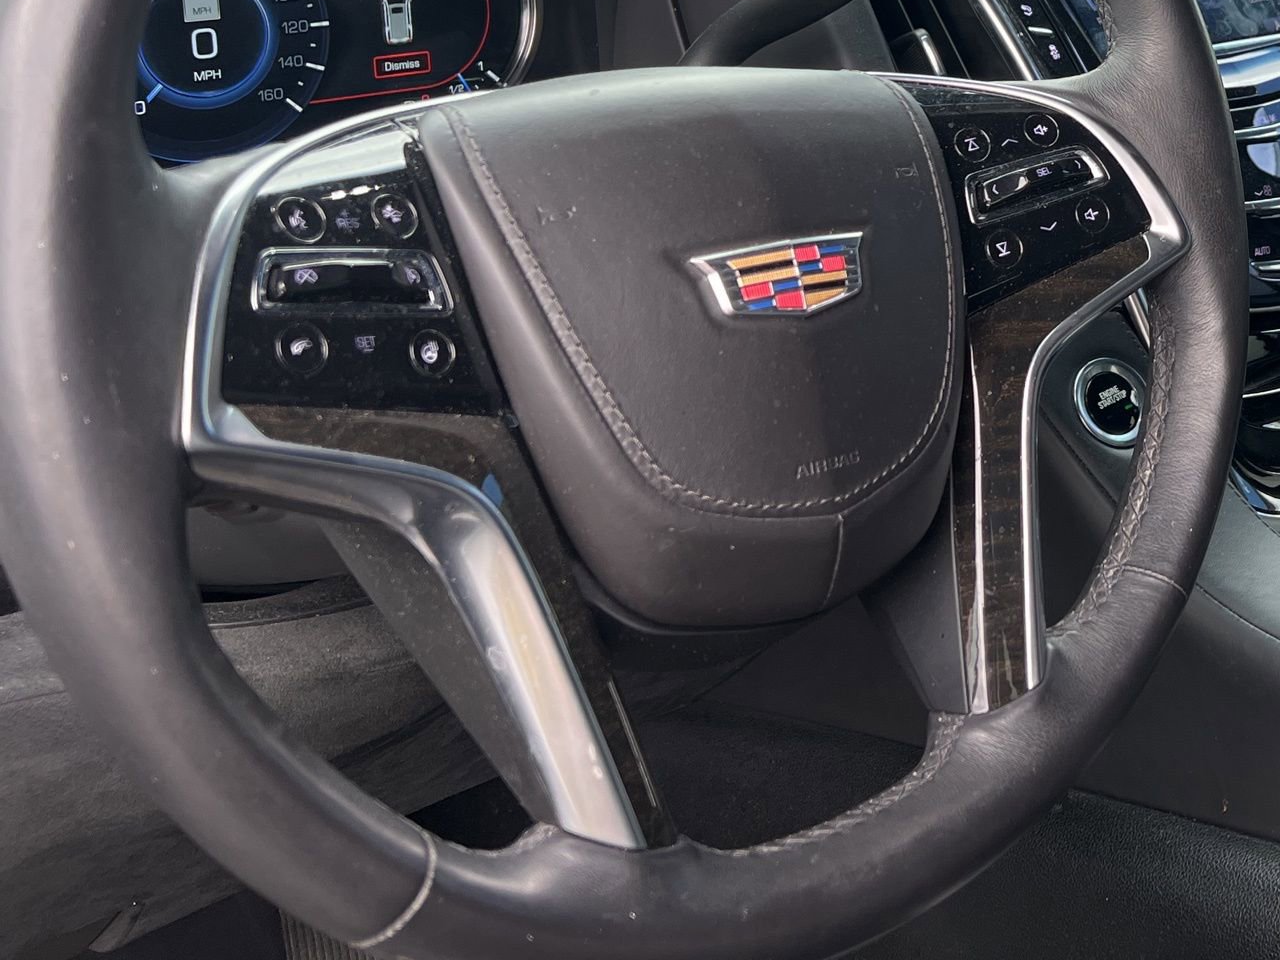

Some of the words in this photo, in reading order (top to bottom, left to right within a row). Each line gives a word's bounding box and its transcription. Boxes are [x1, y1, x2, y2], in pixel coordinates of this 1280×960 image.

[192, 6, 212, 16] MPH
[281, 19, 309, 34] 120
[191, 27, 218, 60] 0
[278, 55, 304, 69] 140
[384, 60, 420, 72] Dismiss
[194, 69, 222, 82] MPH
[258, 87, 284, 102] 160
[134, 100, 146, 115] 0
[1036, 166, 1053, 177] SEL
[1255, 245, 1271, 257] AUTO
[1098, 389, 1127, 410] START/STOP
[1099, 385, 1120, 400] ENGINE
[796, 450, 860, 479] AIRBAG
